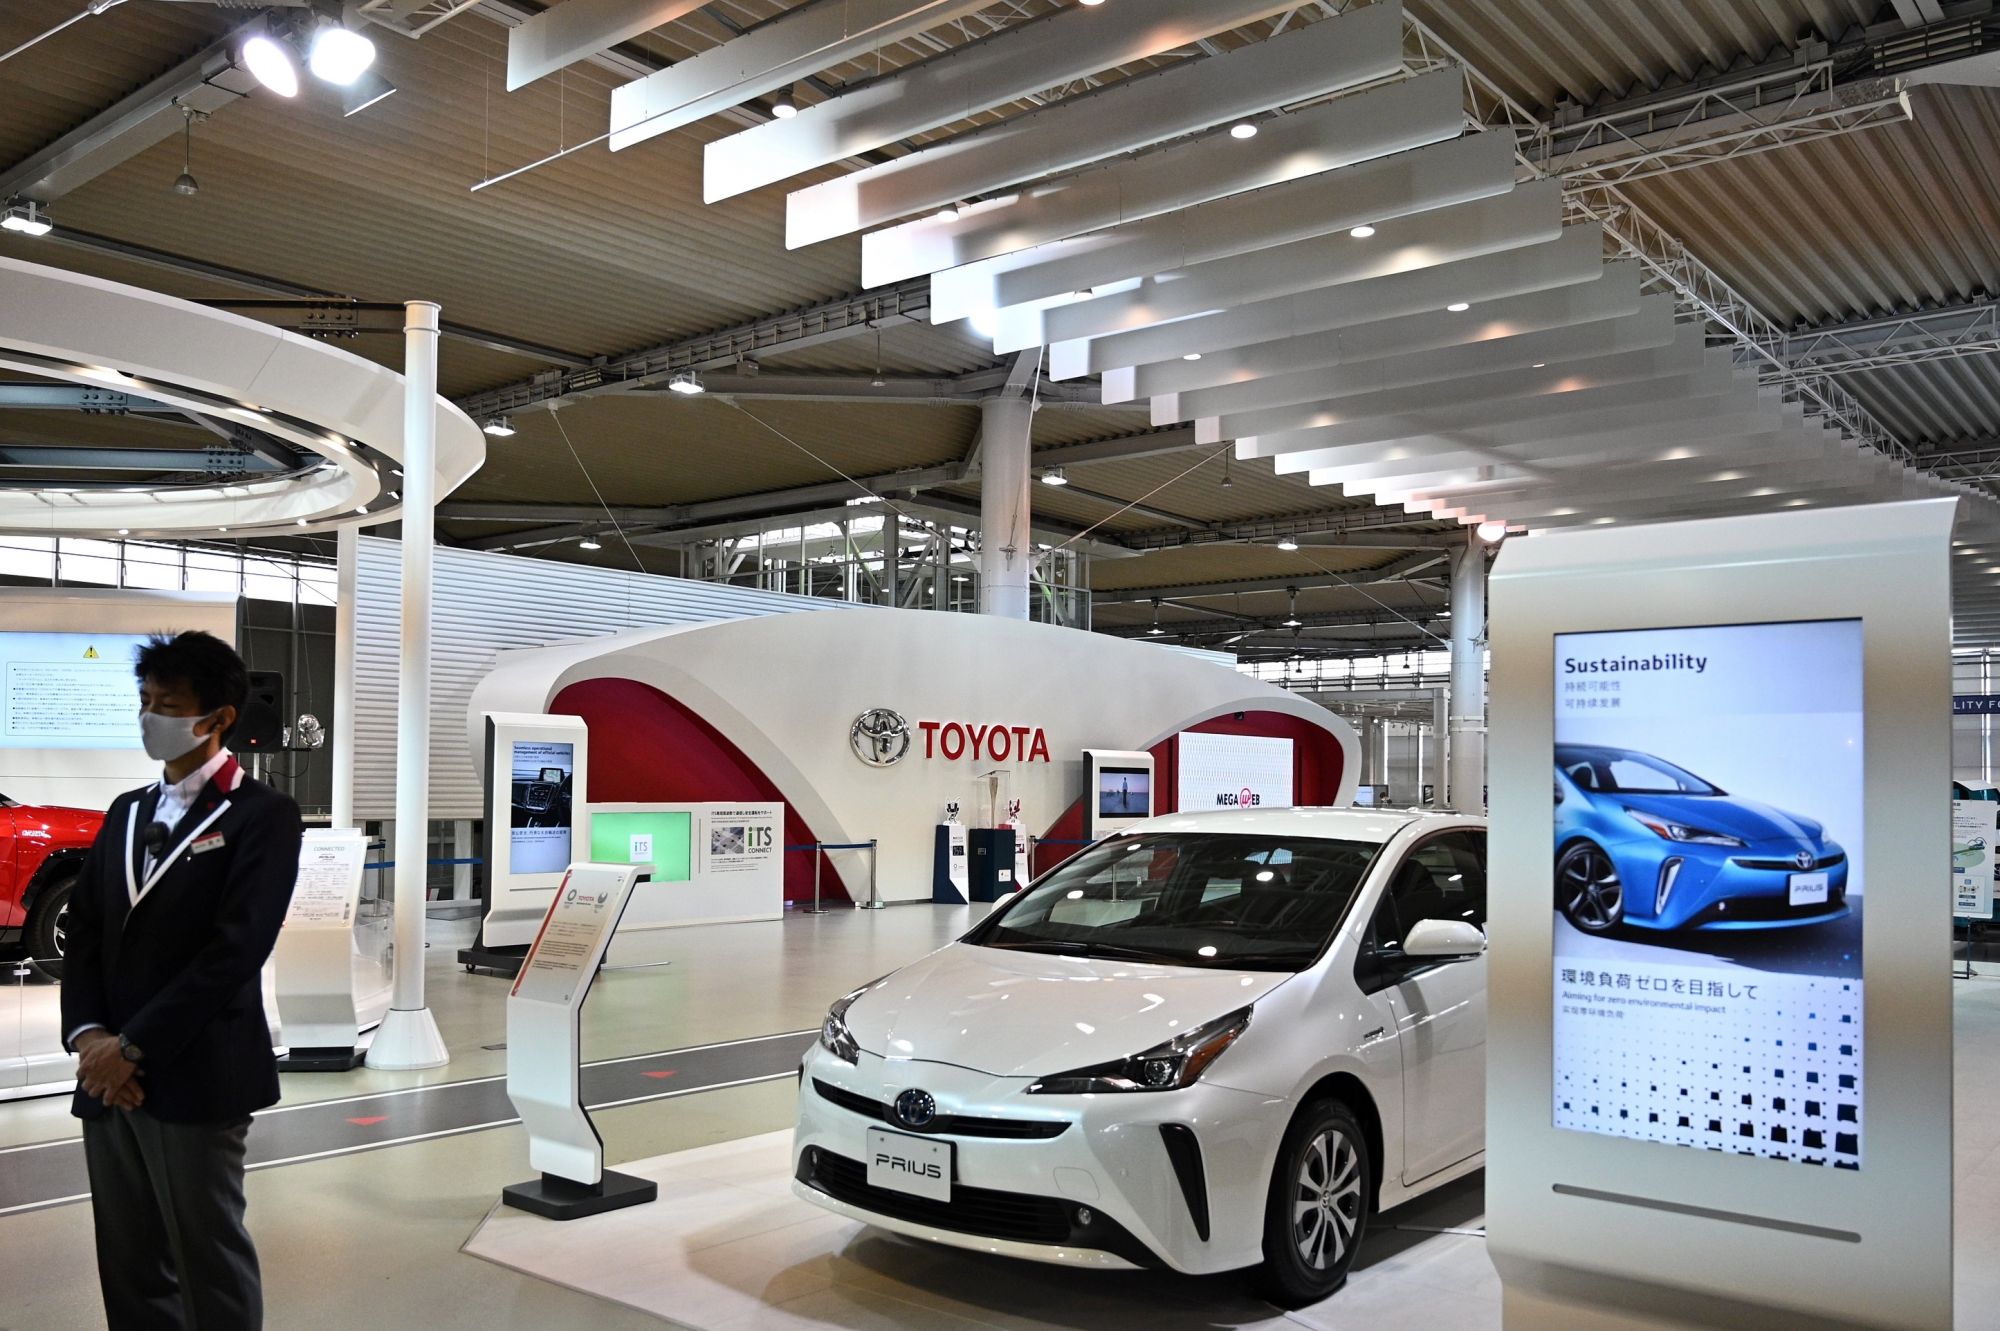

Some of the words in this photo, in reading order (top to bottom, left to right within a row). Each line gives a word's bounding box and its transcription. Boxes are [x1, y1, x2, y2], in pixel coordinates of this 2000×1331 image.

[1564, 653, 1708, 674] Sustainability
[918, 721, 1051, 763] TOYOTA
[1216, 793, 1239, 806] MEGA
[1561, 968, 1759, 1000] 環境負荷ゼロを目指して
[1562, 990, 1592, 1003] Aiming
[1593, 993, 1606, 1003] for
[1607, 995, 1626, 1004] zero
[1628, 997, 1693, 1011] environmental
[1694, 1002, 1726, 1014] impact
[876, 1153, 942, 1179] PRIUS
